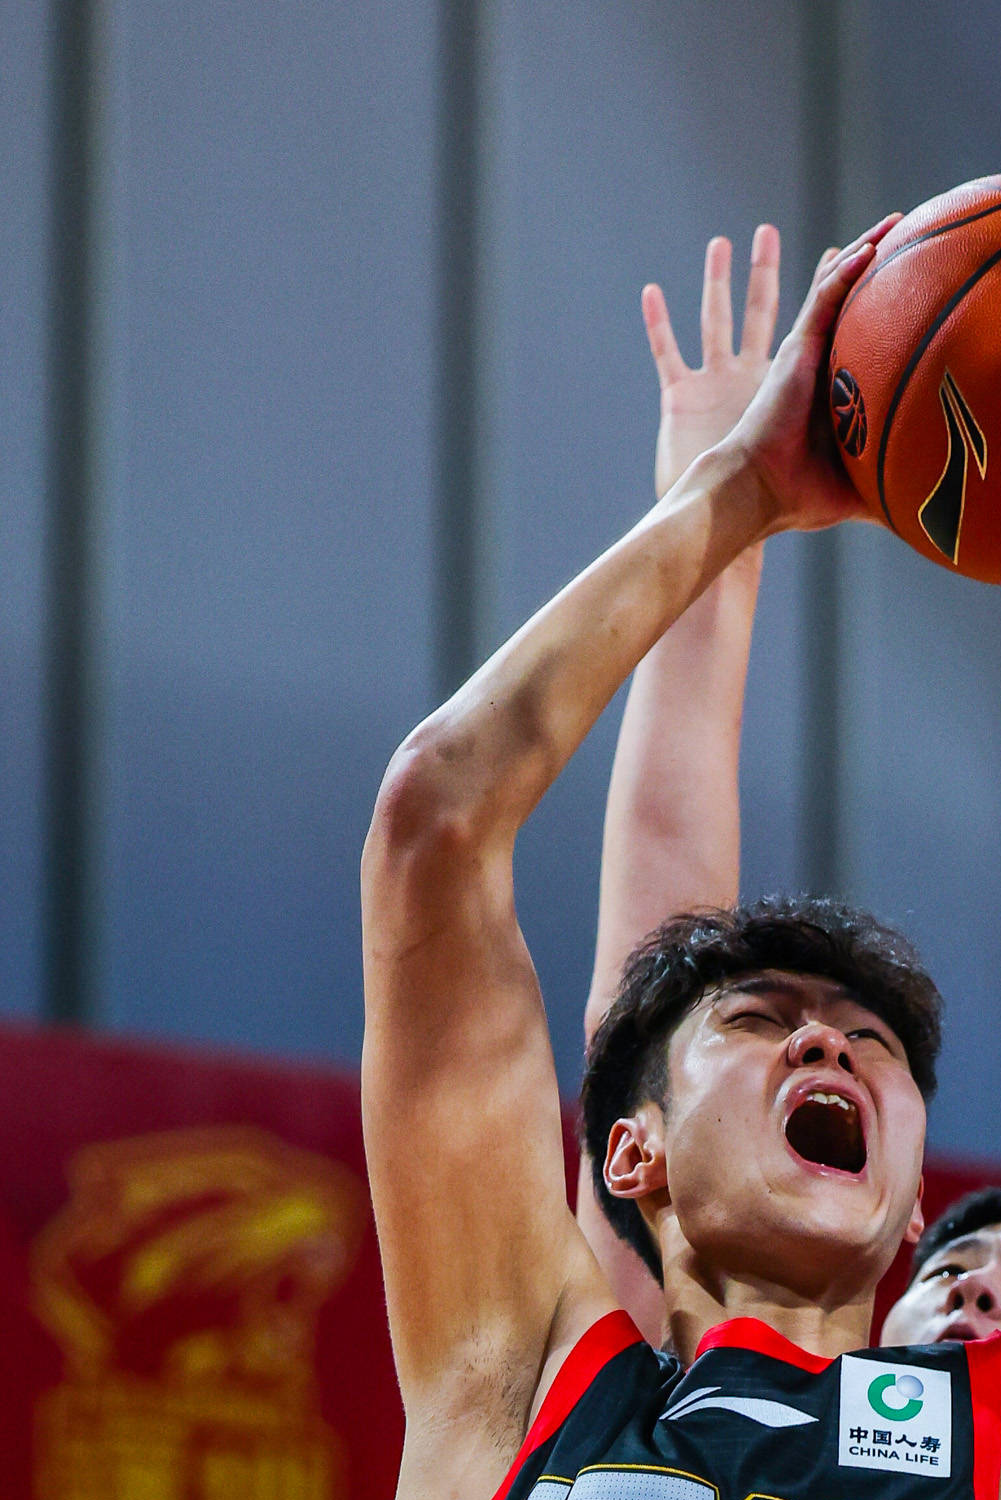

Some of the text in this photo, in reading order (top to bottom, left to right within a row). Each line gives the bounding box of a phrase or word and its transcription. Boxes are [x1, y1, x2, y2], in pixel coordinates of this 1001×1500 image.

[849, 1426, 941, 1453] 中国人寿
[849, 1446, 939, 1466] CHINA LIFE
